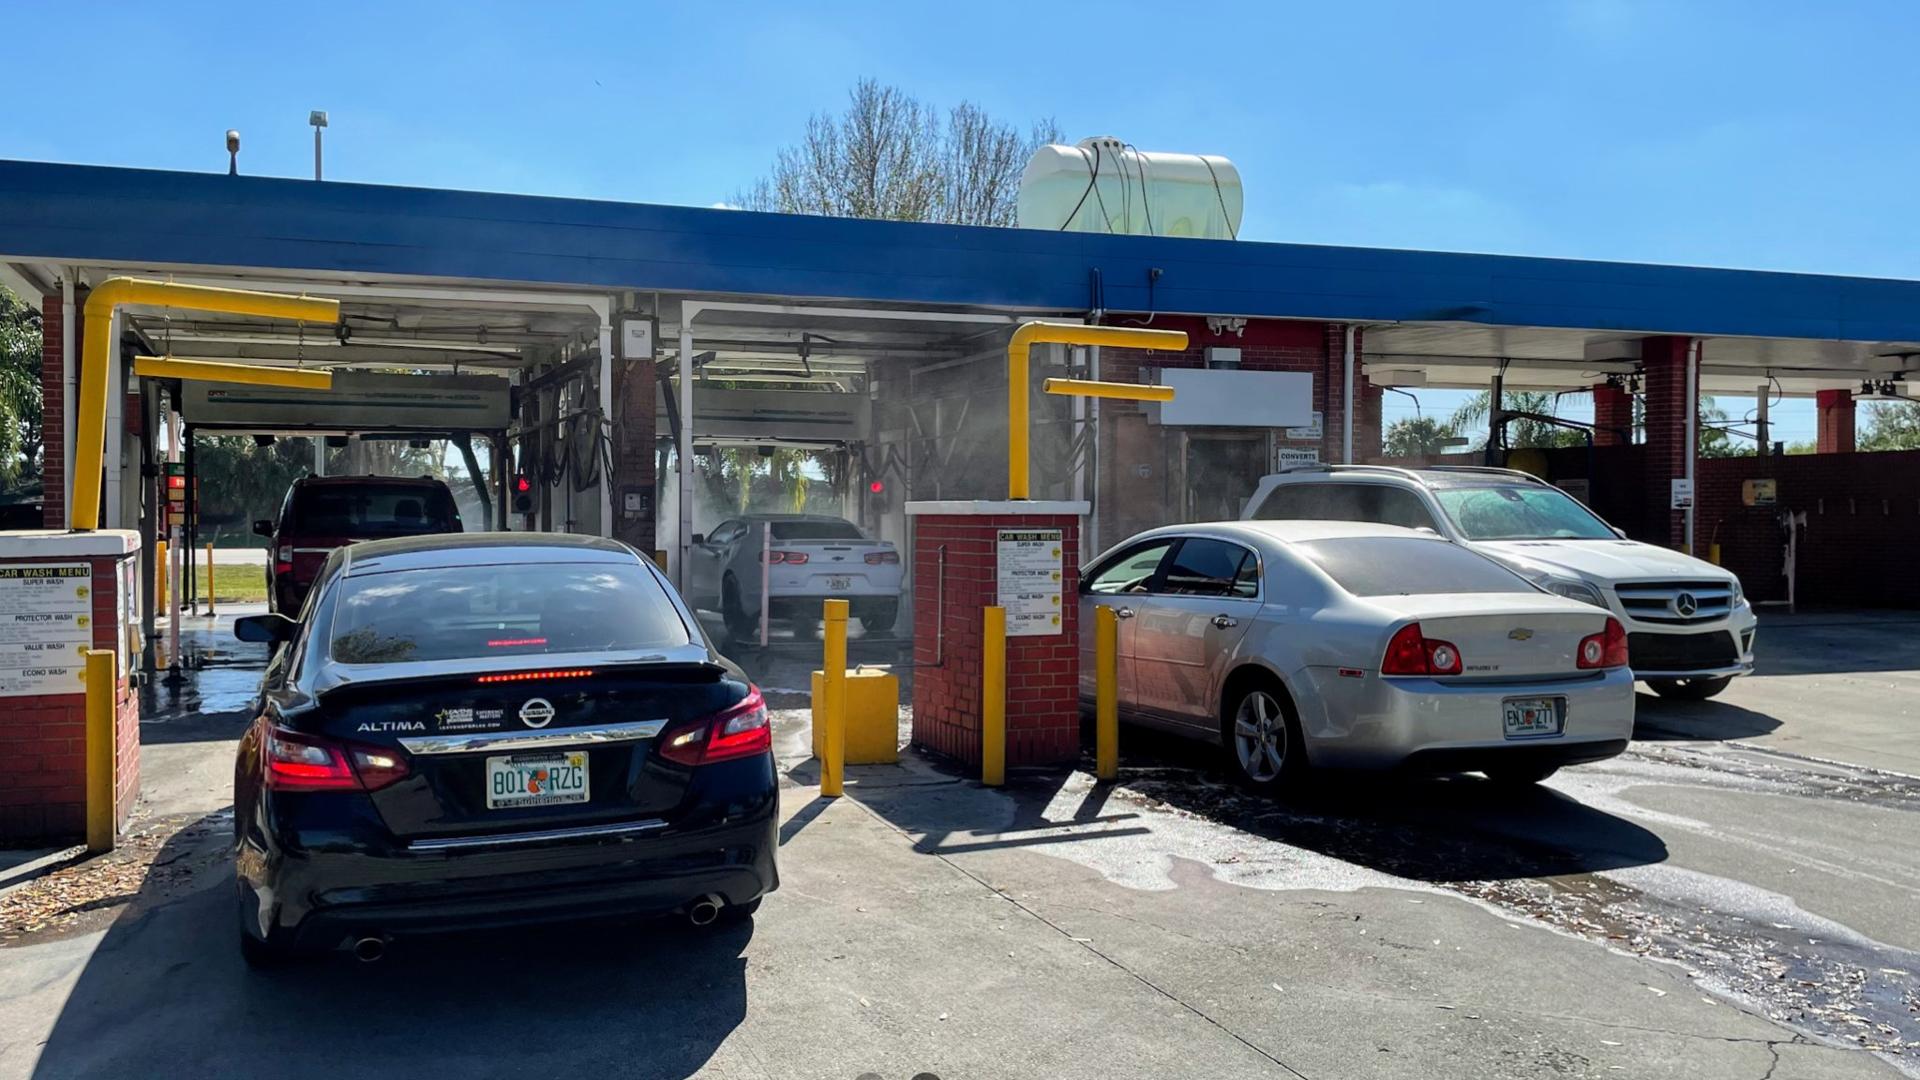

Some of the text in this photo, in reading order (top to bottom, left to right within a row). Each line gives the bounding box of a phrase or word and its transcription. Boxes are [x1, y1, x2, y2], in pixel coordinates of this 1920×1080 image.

[1017, 532, 1037, 540] WASH
[23, 568, 53, 577] WASH
[59, 568, 89, 576] MENU
[22, 669, 46, 677] ECONO
[357, 721, 426, 731] ALTIMA
[494, 767, 583, 795] 801 RZG
